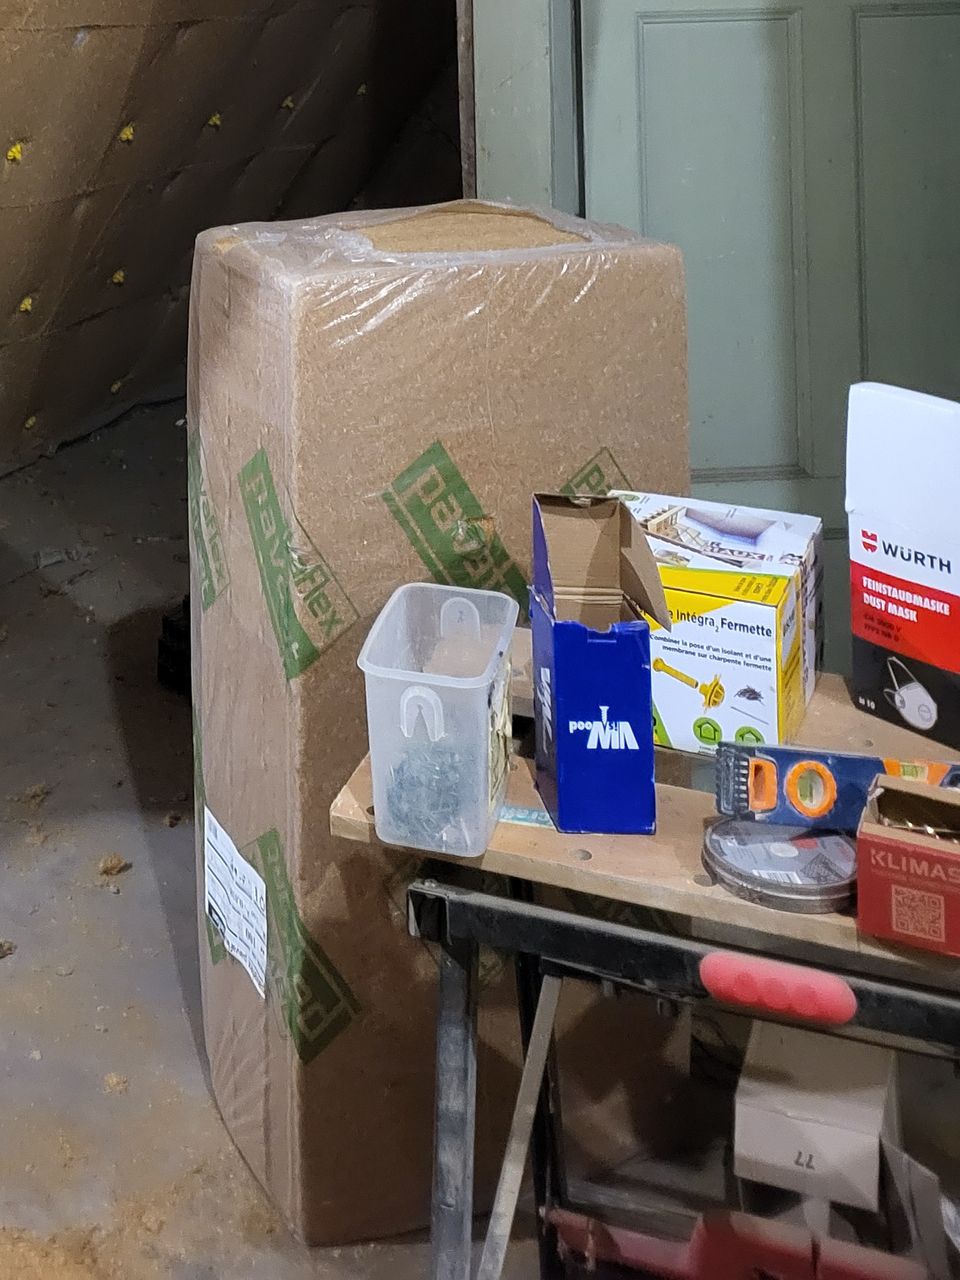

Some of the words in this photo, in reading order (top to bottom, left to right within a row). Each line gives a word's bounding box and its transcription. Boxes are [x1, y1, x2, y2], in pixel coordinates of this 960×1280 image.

[882, 540, 952, 574] WÜRTH
[862, 575, 951, 616] FEINSTAUBMASKE
[863, 592, 886, 612] DUST
[887, 601, 918, 623] MASK
[720, 616, 773, 638] Fermette
[661, 644, 697, 657] membrane
[697, 651, 708, 659] sur
[708, 653, 741, 666] charpente
[742, 660, 772, 672] fermette
[688, 642, 705, 651] pose
[721, 647, 744, 658] isolant
[753, 654, 772, 663] d'une
